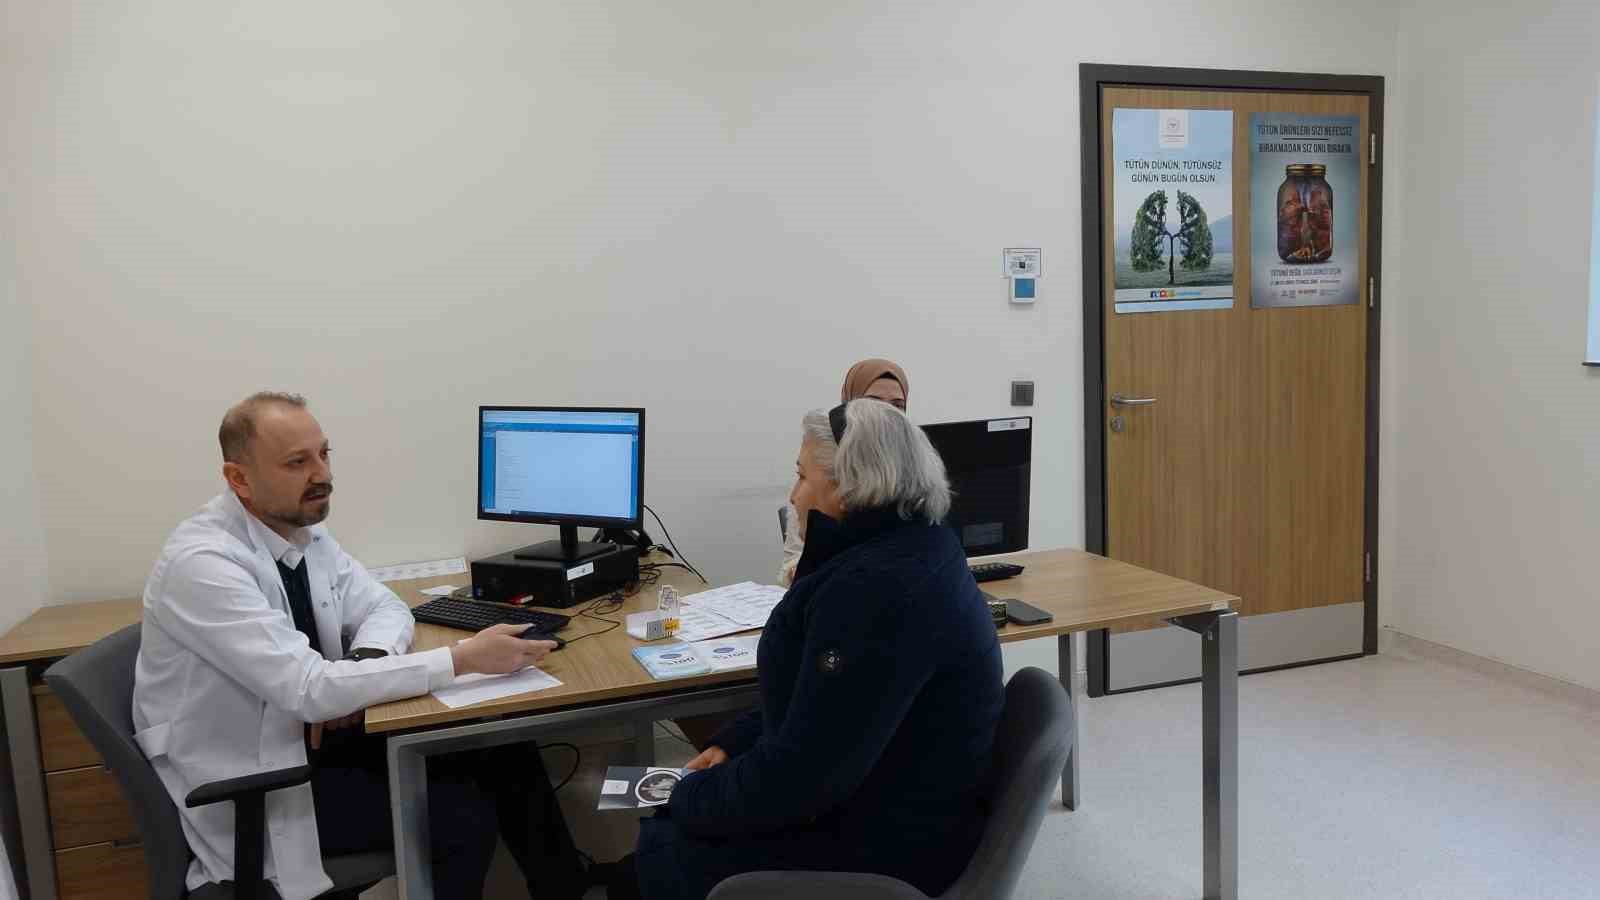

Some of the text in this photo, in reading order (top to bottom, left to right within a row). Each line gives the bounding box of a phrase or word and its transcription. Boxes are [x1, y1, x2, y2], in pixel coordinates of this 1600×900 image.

[1124, 158, 1150, 169] TÜTÜN
[1183, 159, 1222, 170] TÜTÜNSÜZ
[1132, 173, 1159, 183] GÜNÜN
[1161, 173, 1188, 183] BUGÜN
